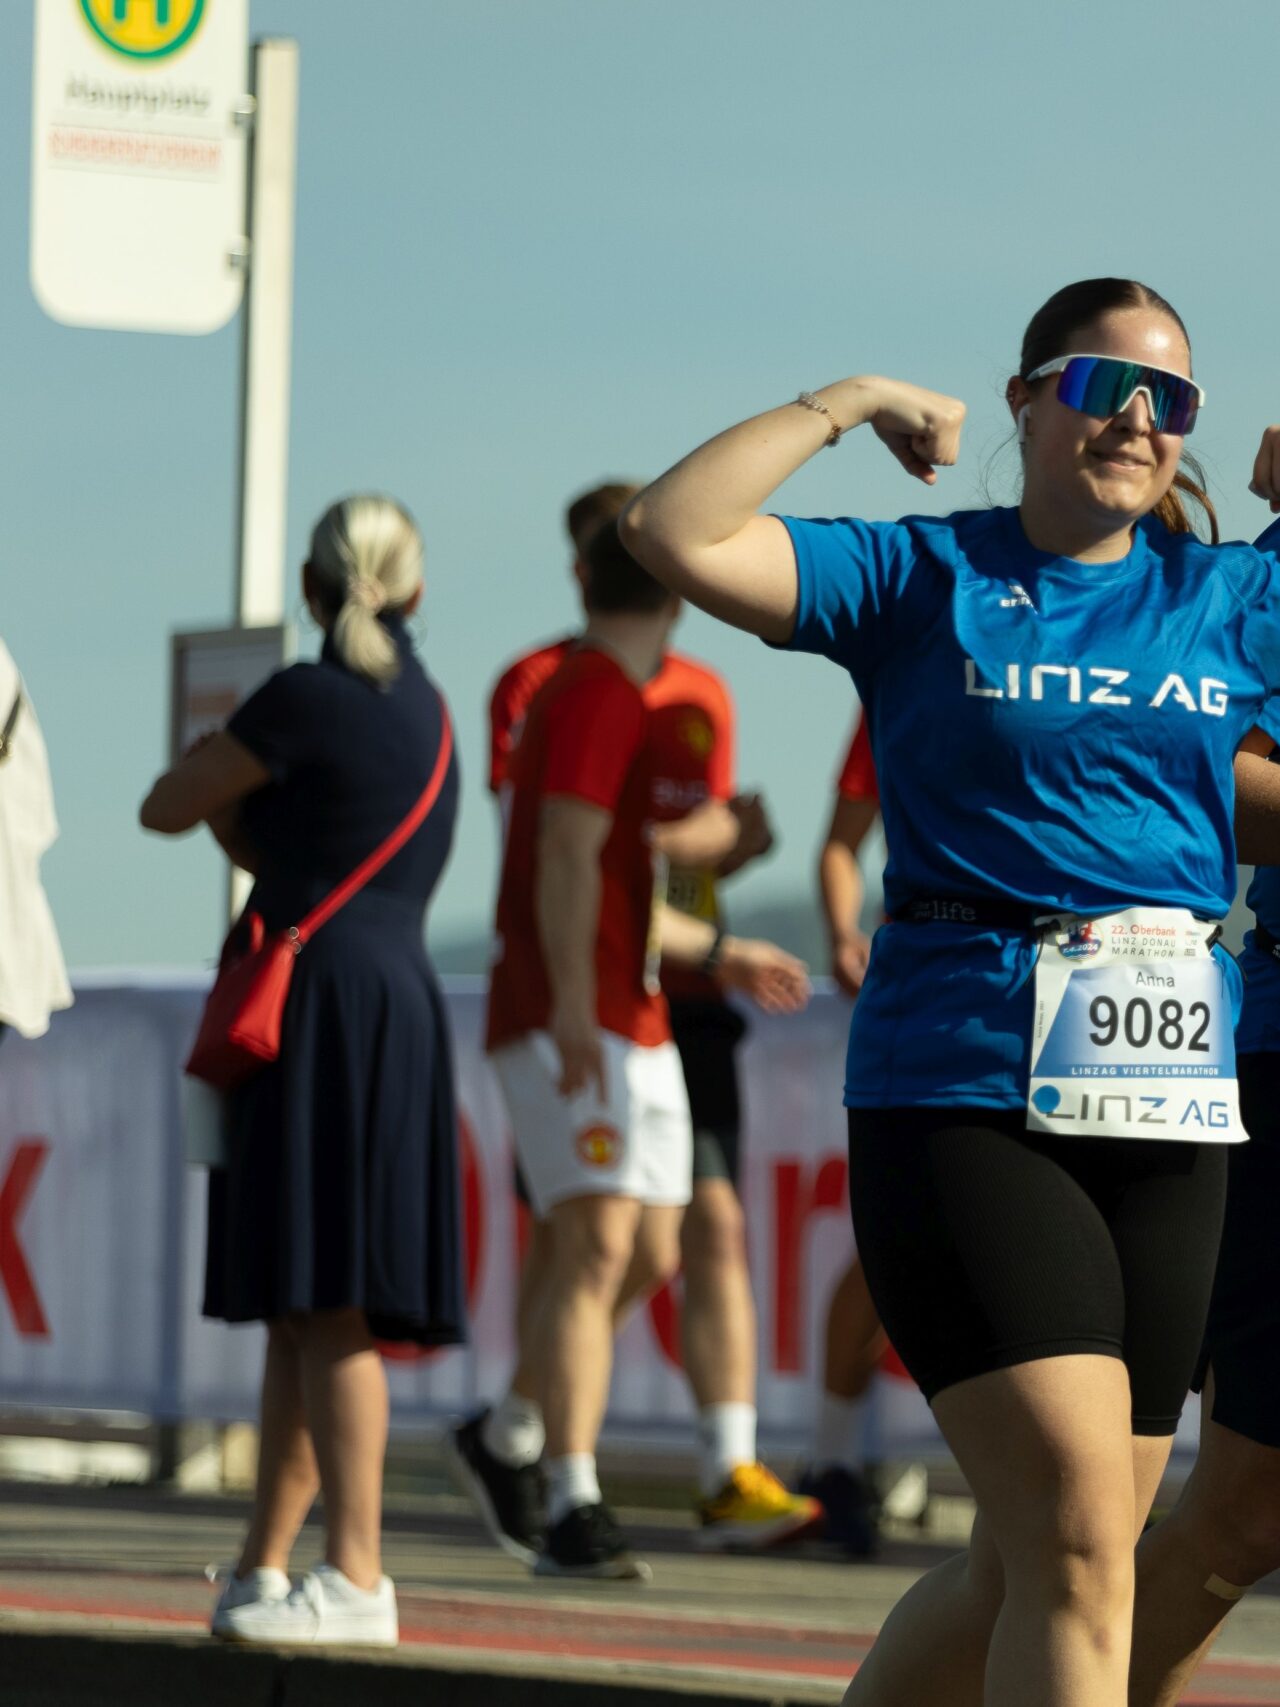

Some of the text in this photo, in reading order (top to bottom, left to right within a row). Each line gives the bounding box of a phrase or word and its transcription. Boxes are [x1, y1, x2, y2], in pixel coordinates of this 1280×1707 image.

[964, 659, 1229, 716] LINZ AG
[1130, 924, 1176, 936] Oberbank
[1111, 936, 1175, 947] LINZ DONAU
[1111, 947, 1175, 958] MARATHON
[1135, 972, 1175, 988] Anna
[1089, 995, 1211, 1052] 9082
[1179, 1099, 1230, 1127] AG
